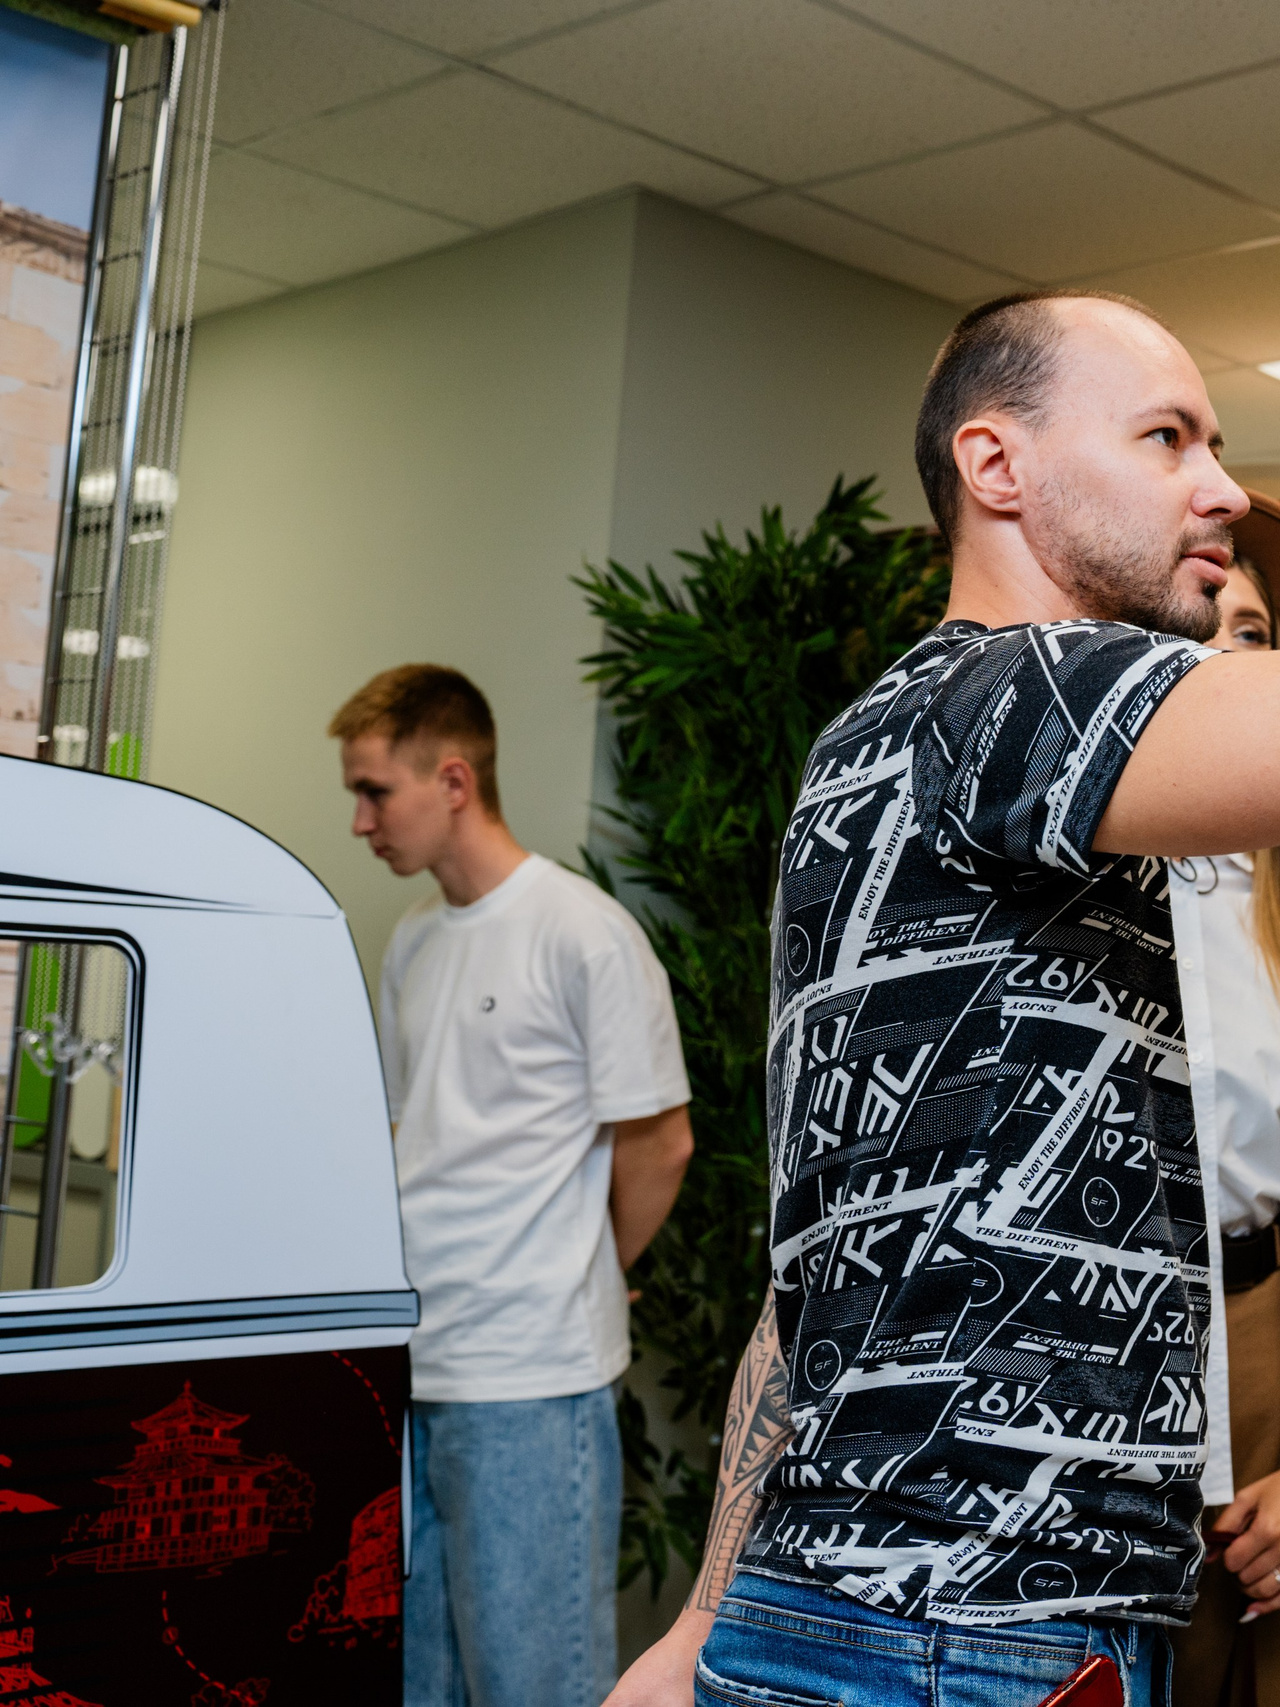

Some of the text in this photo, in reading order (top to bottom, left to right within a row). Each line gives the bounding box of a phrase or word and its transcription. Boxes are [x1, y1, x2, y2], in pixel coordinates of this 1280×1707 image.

[976, 690, 1018, 776] DIFFIRENT
[1046, 685, 1122, 849] ENJOY THE DIFFIRENT
[808, 771, 873, 801] DIFFIRENT
[958, 762, 975, 814] ENJOY
[858, 790, 914, 921] ENJOY THE DIFFIRENT
[899, 919, 930, 933] THE
[1088, 909, 1142, 936] DIFFIRENT
[881, 923, 972, 948] DIFFIRENT
[1135, 939, 1164, 955] ENJOY
[1009, 1001, 1058, 1013] ENJOY
[1018, 1088, 1090, 1191] ENJOY THE DIFFIRENT
[1091, 1196, 1109, 1207] SF
[801, 1225, 830, 1247] ENJOY
[976, 1226, 1079, 1252] THE DIFFIRENT
[859, 1340, 942, 1360] DIFFIRENT
[875, 1337, 907, 1350] THE
[1020, 1332, 1091, 1352] DIFFIRENT
[814, 1359, 833, 1372] SF
[1051, 1348, 1114, 1365] ENJOY THE
[1107, 1448, 1160, 1459] DIFFIRENT
[947, 1543, 977, 1567] ENJOY
[1033, 1577, 1064, 1589] SF
[928, 1604, 1021, 1619] DIFFIRENT
